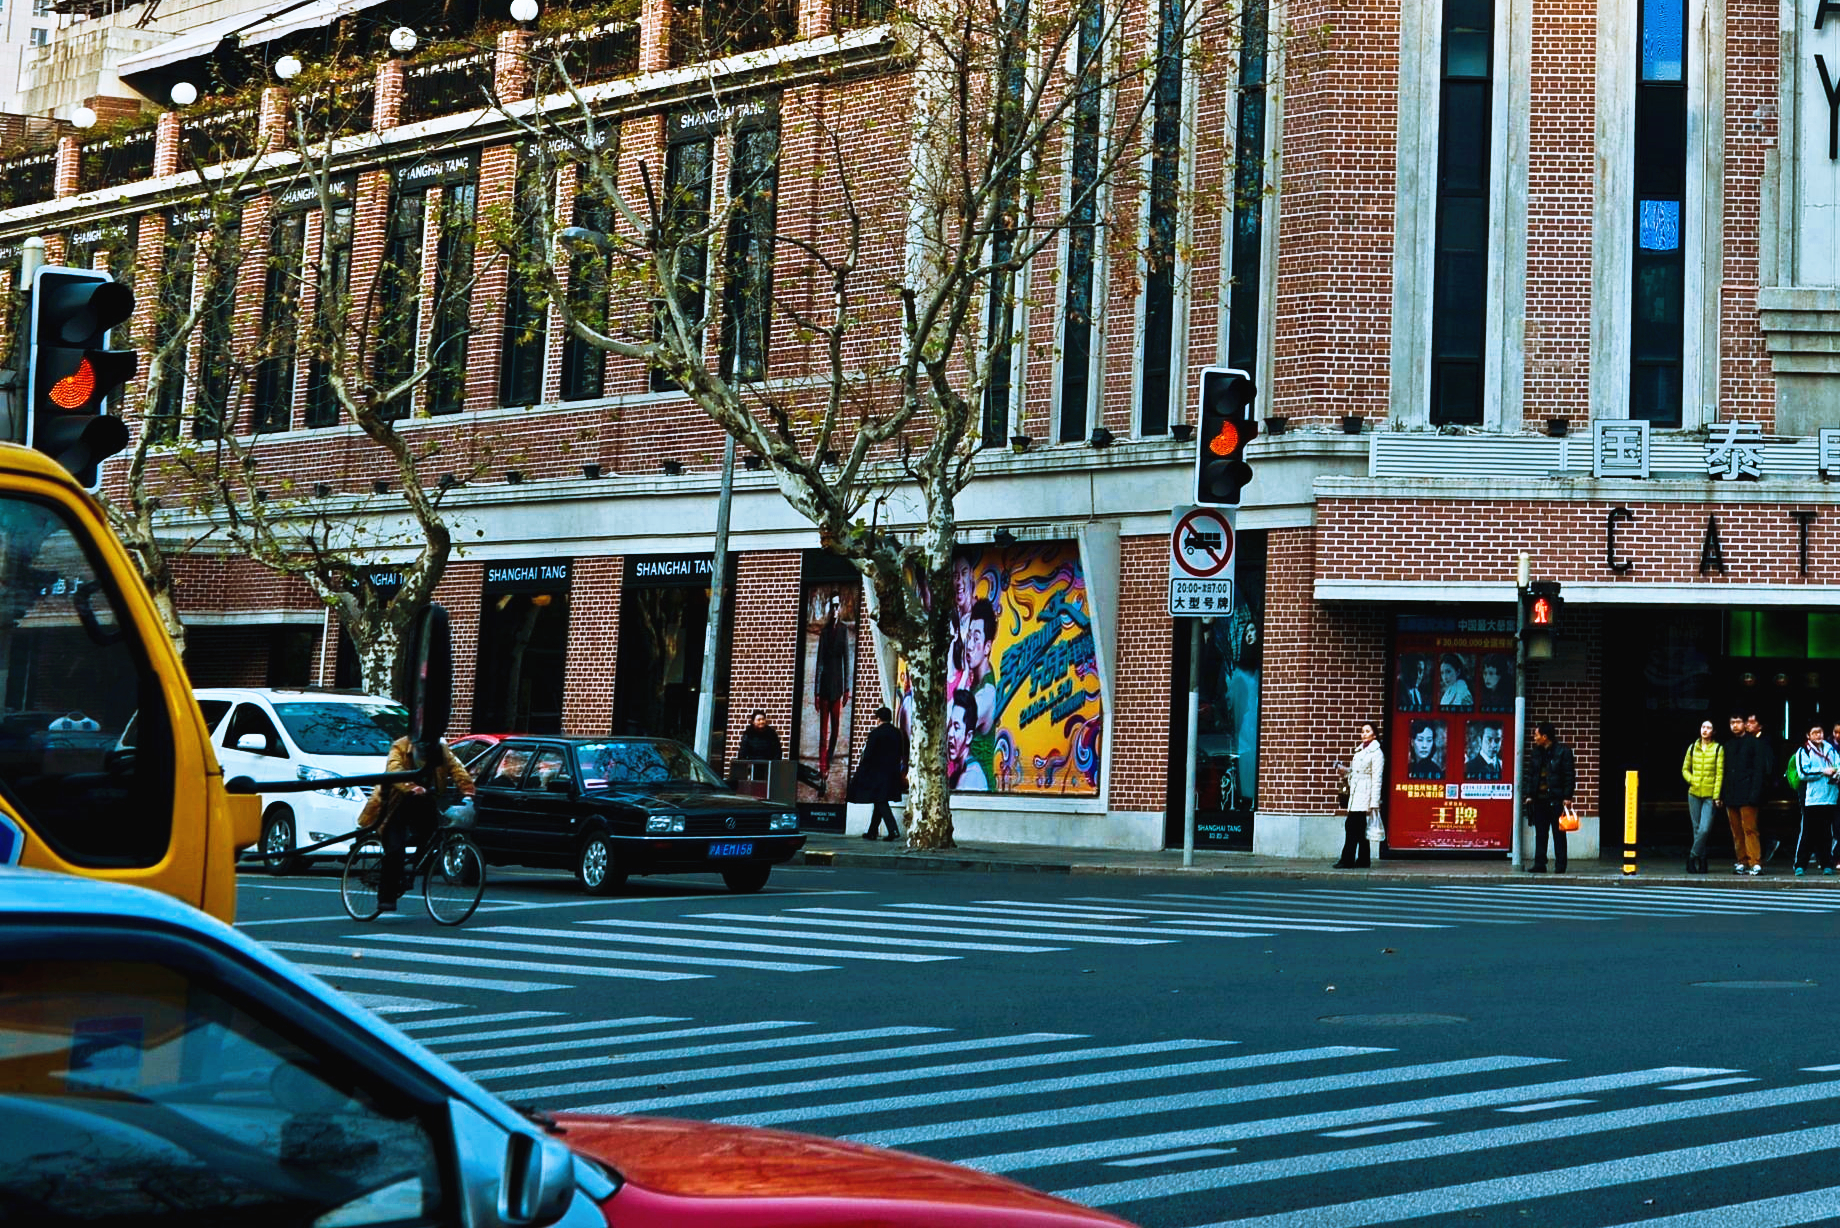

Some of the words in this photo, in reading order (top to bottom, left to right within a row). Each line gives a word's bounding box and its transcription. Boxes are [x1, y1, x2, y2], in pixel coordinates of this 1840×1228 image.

[488, 567, 538, 583] SHANGHAI
[540, 565, 567, 580] TANG
[636, 559, 692, 576] SHANGHAI
[694, 559, 714, 574] TAN
[1174, 596, 1228, 609] 大型号牌
[1430, 806, 1478, 825] 王牌
